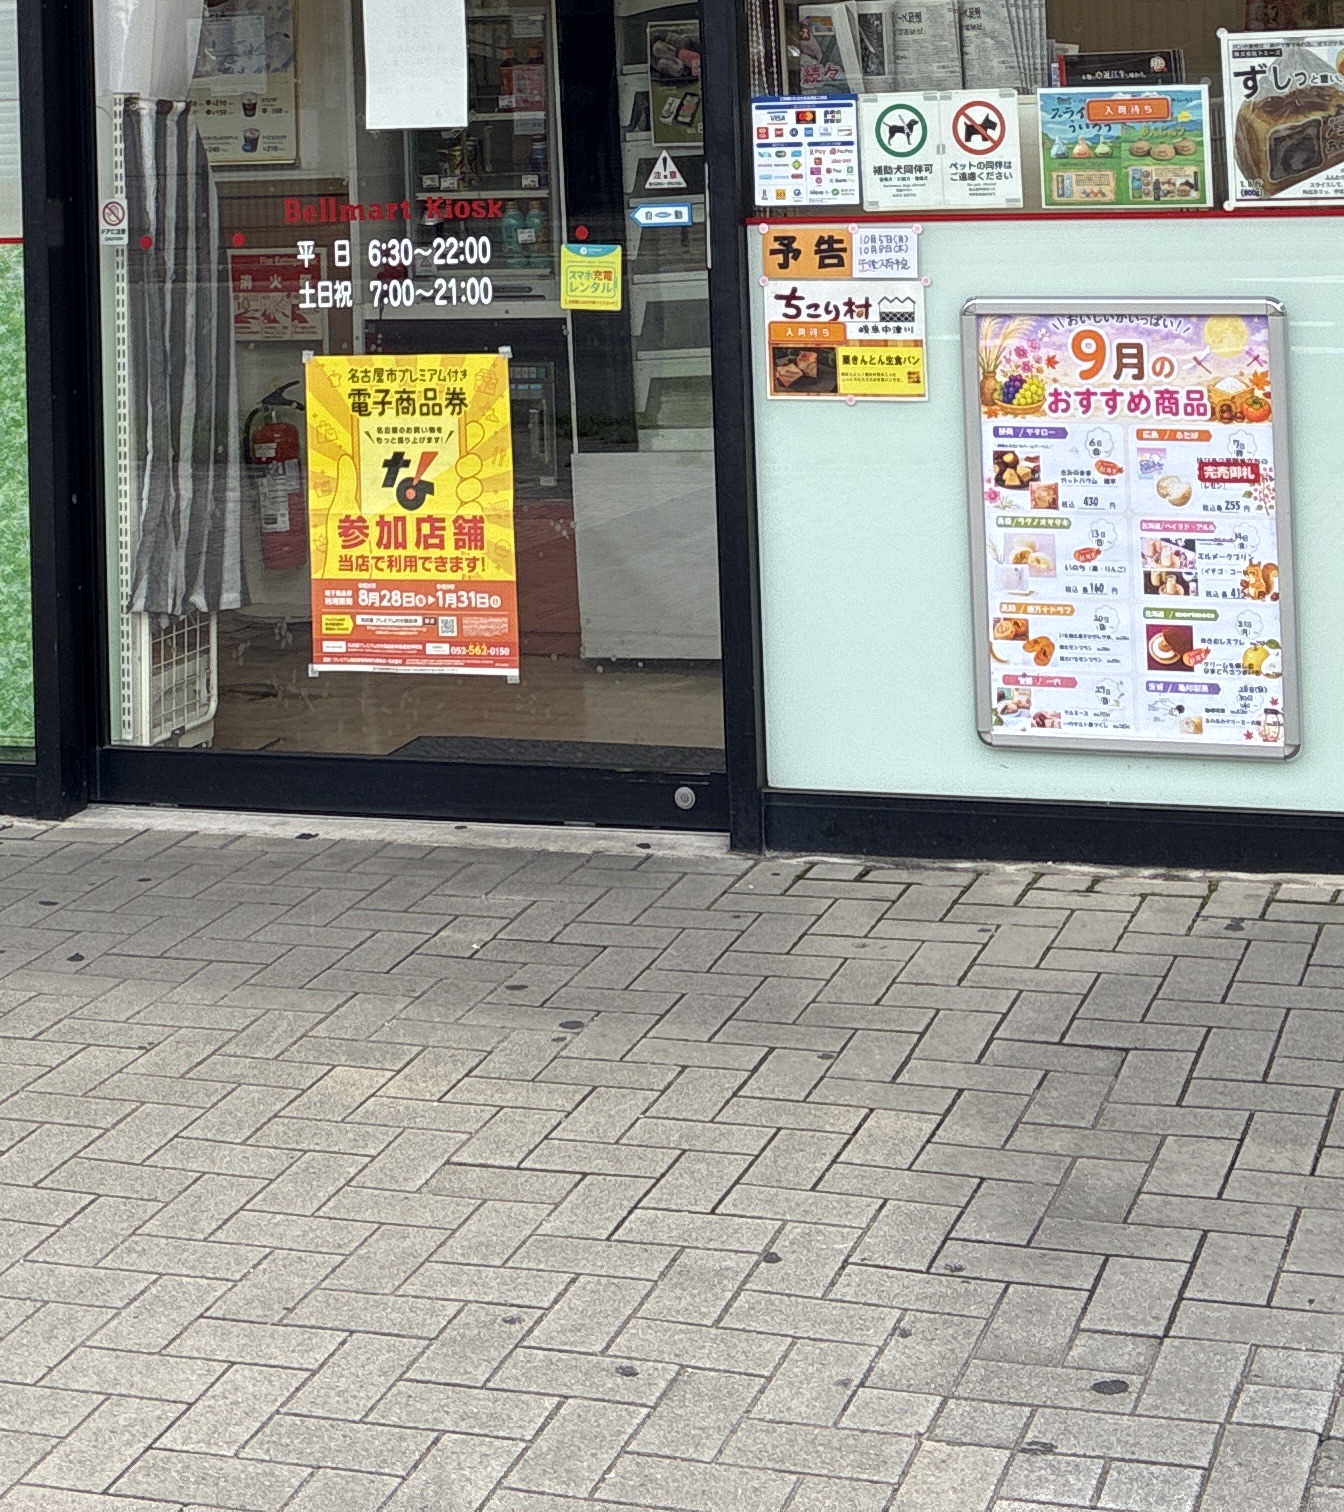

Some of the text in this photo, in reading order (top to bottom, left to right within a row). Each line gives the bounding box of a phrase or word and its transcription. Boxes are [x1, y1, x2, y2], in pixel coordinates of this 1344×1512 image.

[1051, 107, 1085, 120] スライ
[873, 164, 934, 176] 補助犬同伴可
[949, 161, 1012, 170] ペットの同伴は
[950, 172, 1013, 181] ご遠慮ください
[284, 195, 504, 225] Bellmart Kiosk
[769, 234, 848, 270] 予告
[569, 270, 613, 281] スマホ充電
[298, 280, 353, 309] 土日祝
[569, 283, 613, 294] レンタル
[774, 286, 873, 322] ちこり村
[1071, 329, 1175, 381] 9月の
[348, 368, 468, 383] 名古屋市プレミアム付き
[348, 387, 468, 417] 電子商品券
[1047, 388, 1207, 417] おすすめ商品
[337, 514, 485, 551] 参加店舗
[338, 554, 486, 574] 当店で利用できます!
